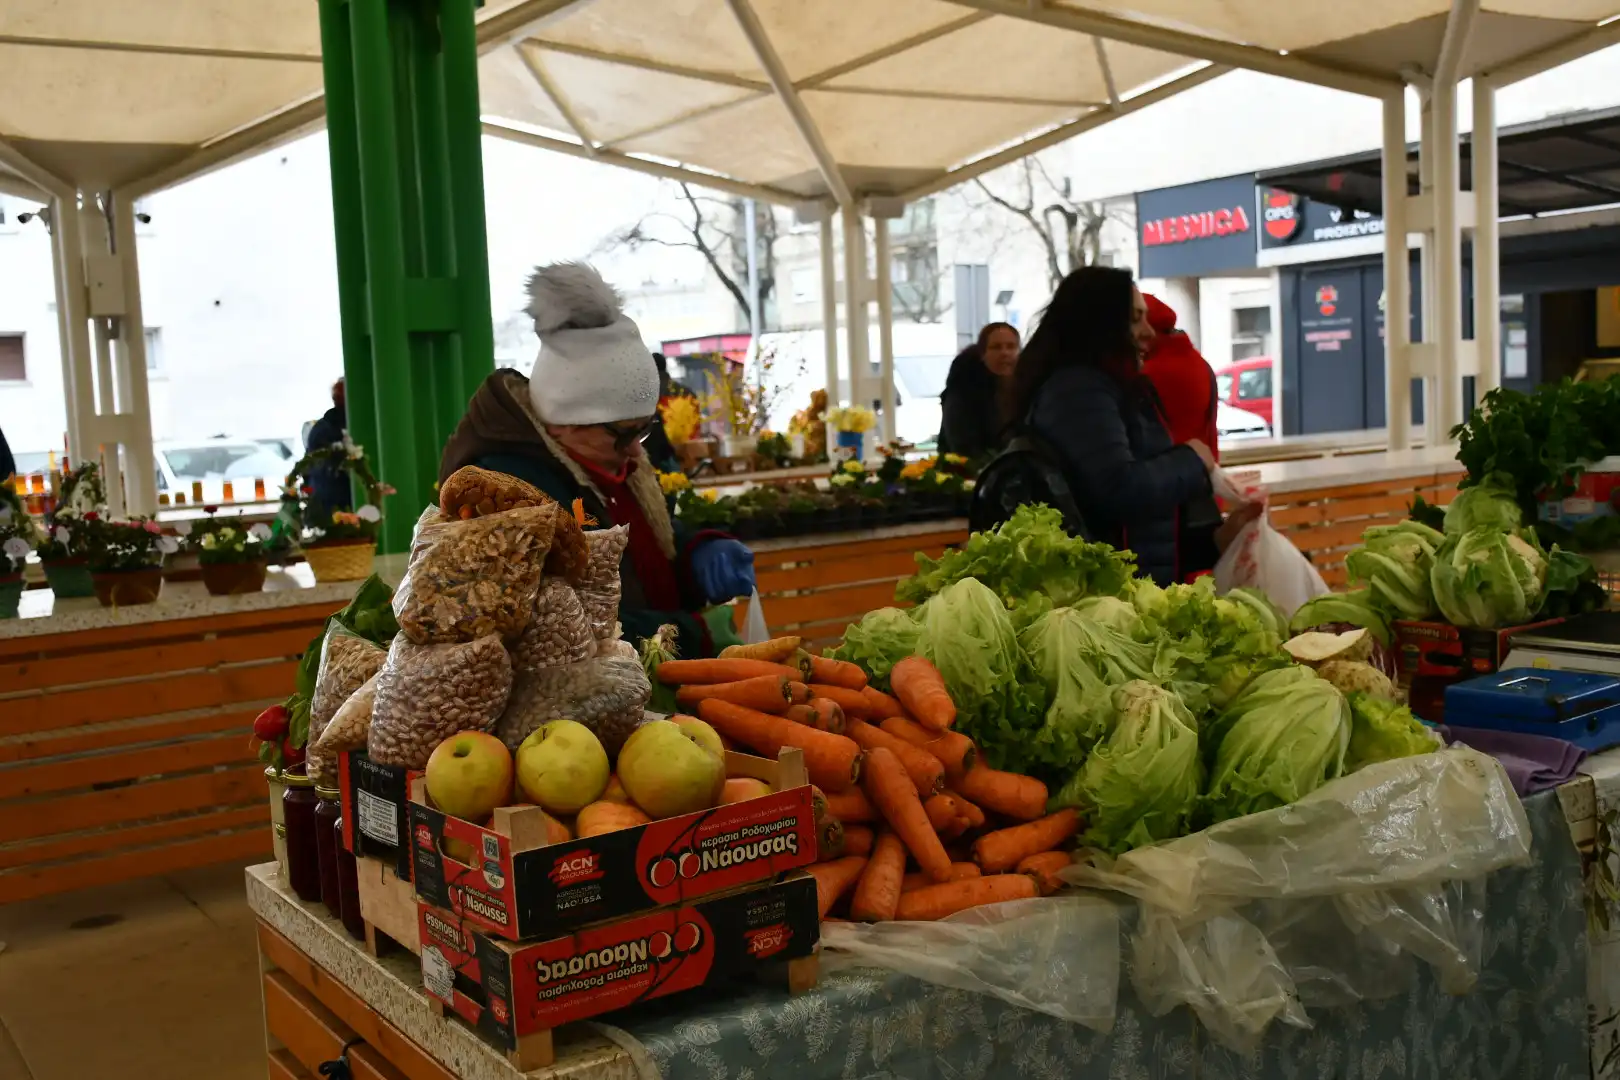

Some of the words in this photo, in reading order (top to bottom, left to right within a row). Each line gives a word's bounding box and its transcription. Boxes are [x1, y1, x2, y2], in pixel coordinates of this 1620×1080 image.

[1143, 206, 1249, 246] MESNICA
[1265, 205, 1294, 222] OPG
[701, 831, 739, 849] κεράσια
[741, 816, 796, 839] Ροδοχωρίου
[559, 856, 593, 873] ACN
[702, 832, 797, 872] Νάουσας
[466, 894, 508, 924] Naoussa
[557, 894, 602, 911] NAOUSSA
[425, 912, 460, 944] Naoussa
[537, 939, 647, 983] Νάουσας
[606, 962, 648, 980] κεράσια
[538, 974, 604, 1000] Ροδοχωρίου
